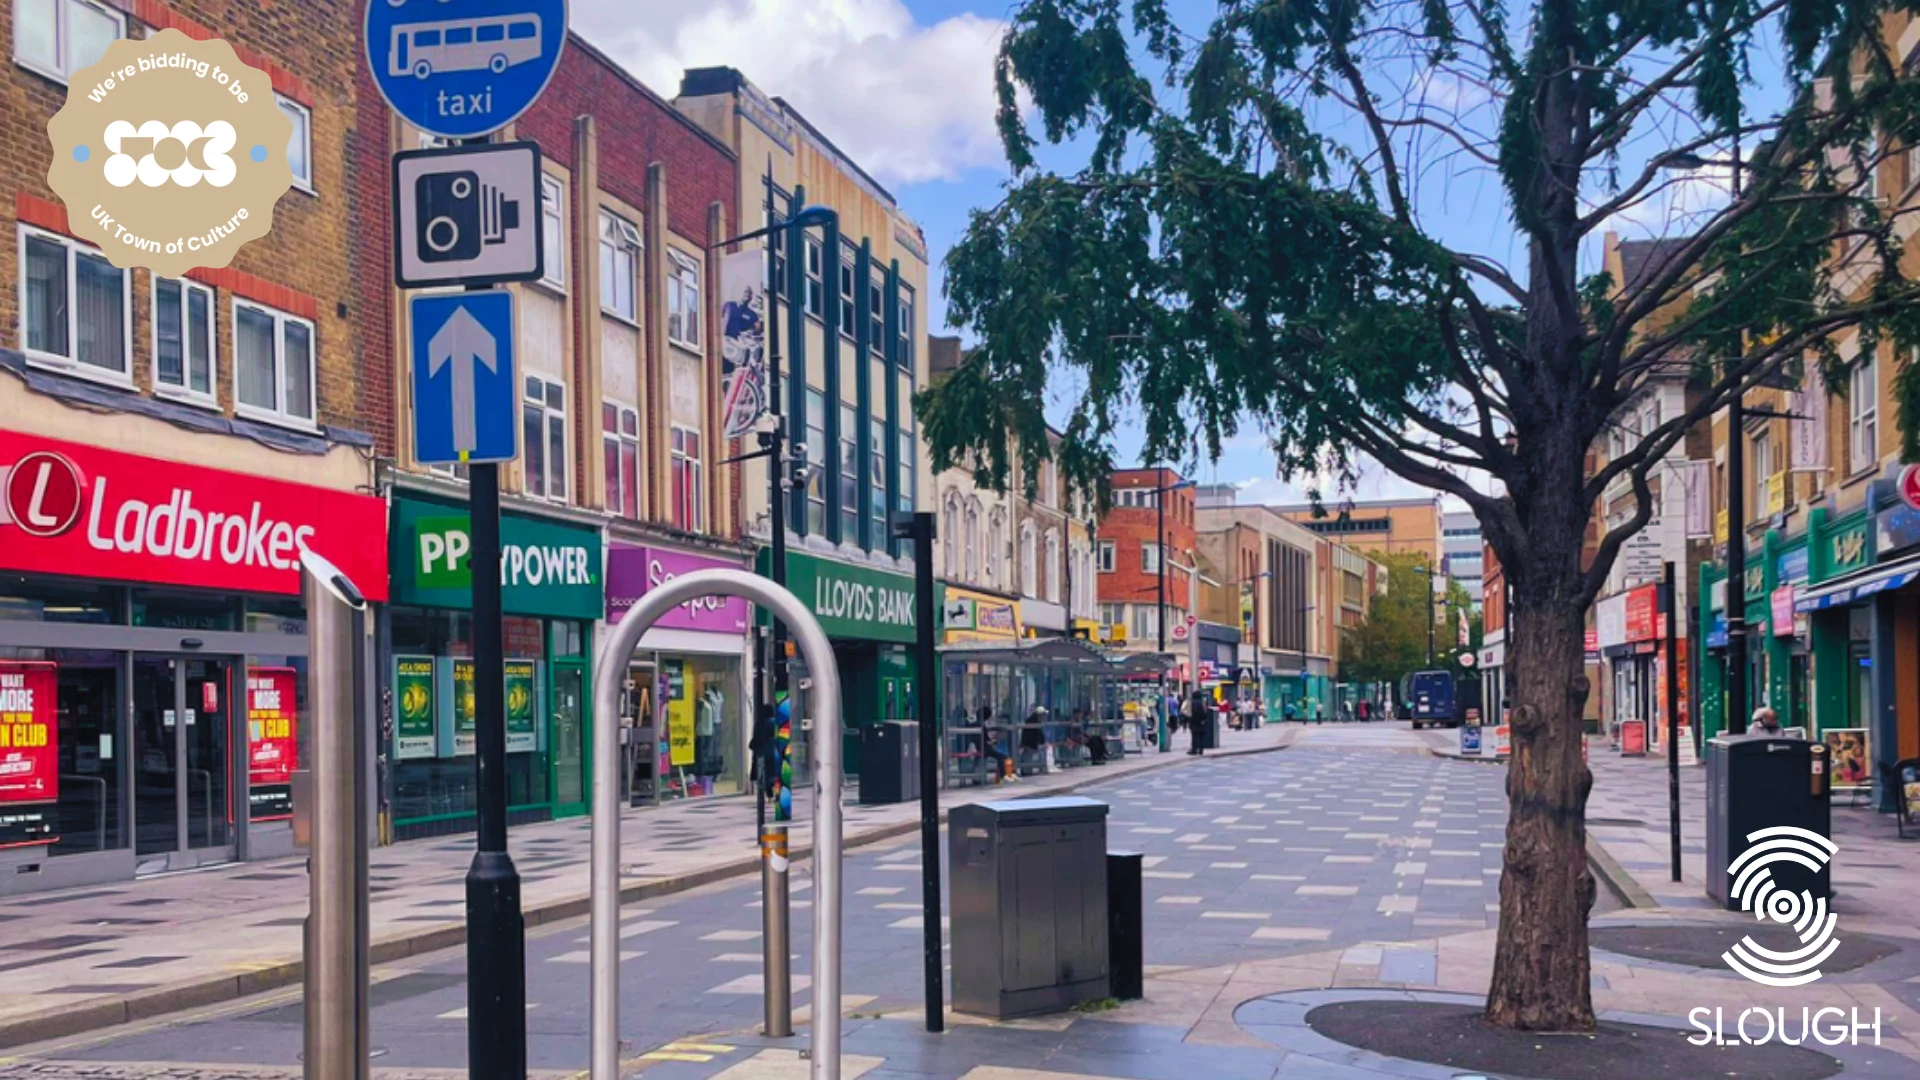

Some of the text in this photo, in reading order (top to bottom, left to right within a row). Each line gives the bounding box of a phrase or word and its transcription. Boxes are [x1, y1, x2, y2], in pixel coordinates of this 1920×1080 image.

[436, 85, 492, 116] taxi
[87, 476, 315, 571] Ladbrokes
[816, 575, 915, 627] LLOYDS BANK
[13, 723, 48, 748] CLUB
